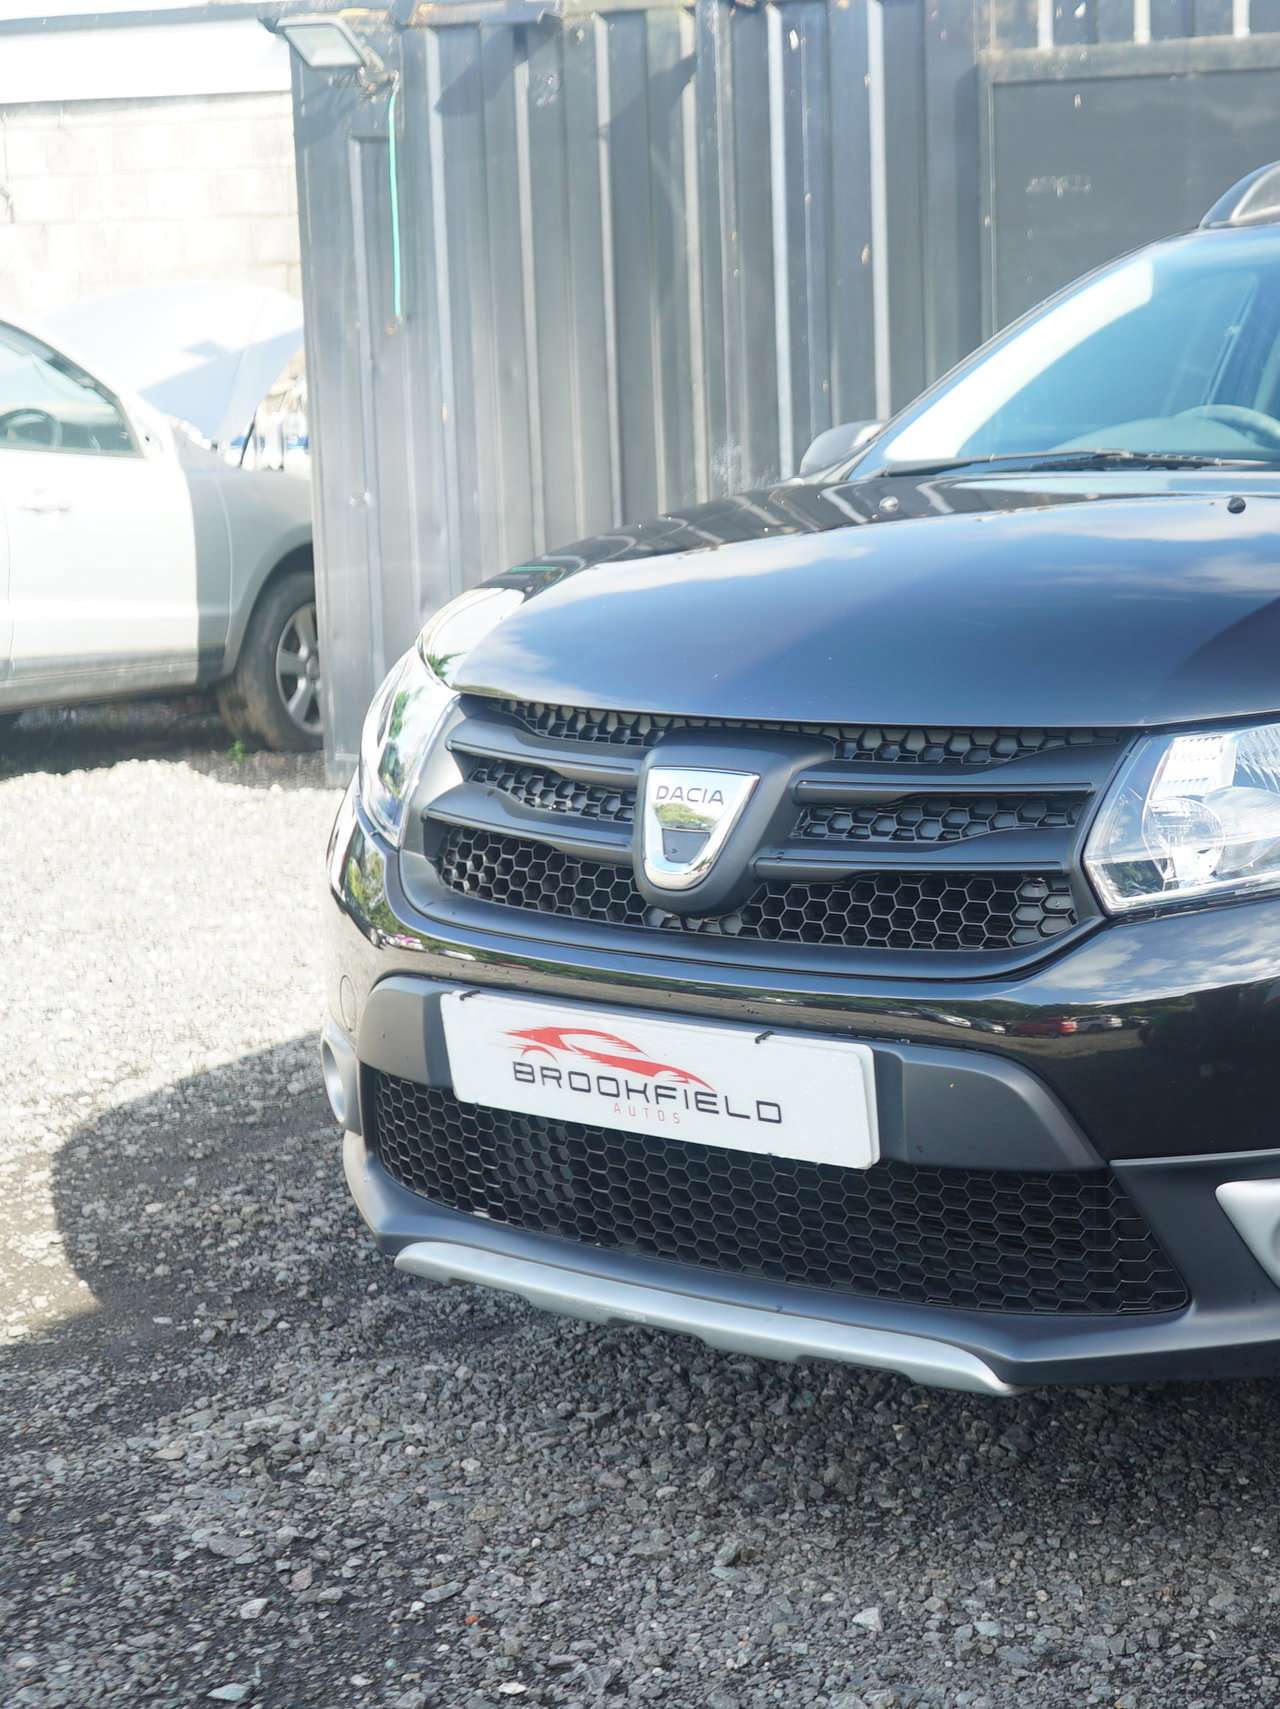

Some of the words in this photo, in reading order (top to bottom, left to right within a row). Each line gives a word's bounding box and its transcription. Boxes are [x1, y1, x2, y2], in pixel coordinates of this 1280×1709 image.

[655, 785, 725, 805] DACIA
[512, 1061, 783, 1124] BROOKFIELD
[613, 1102, 681, 1124] AUTOS
